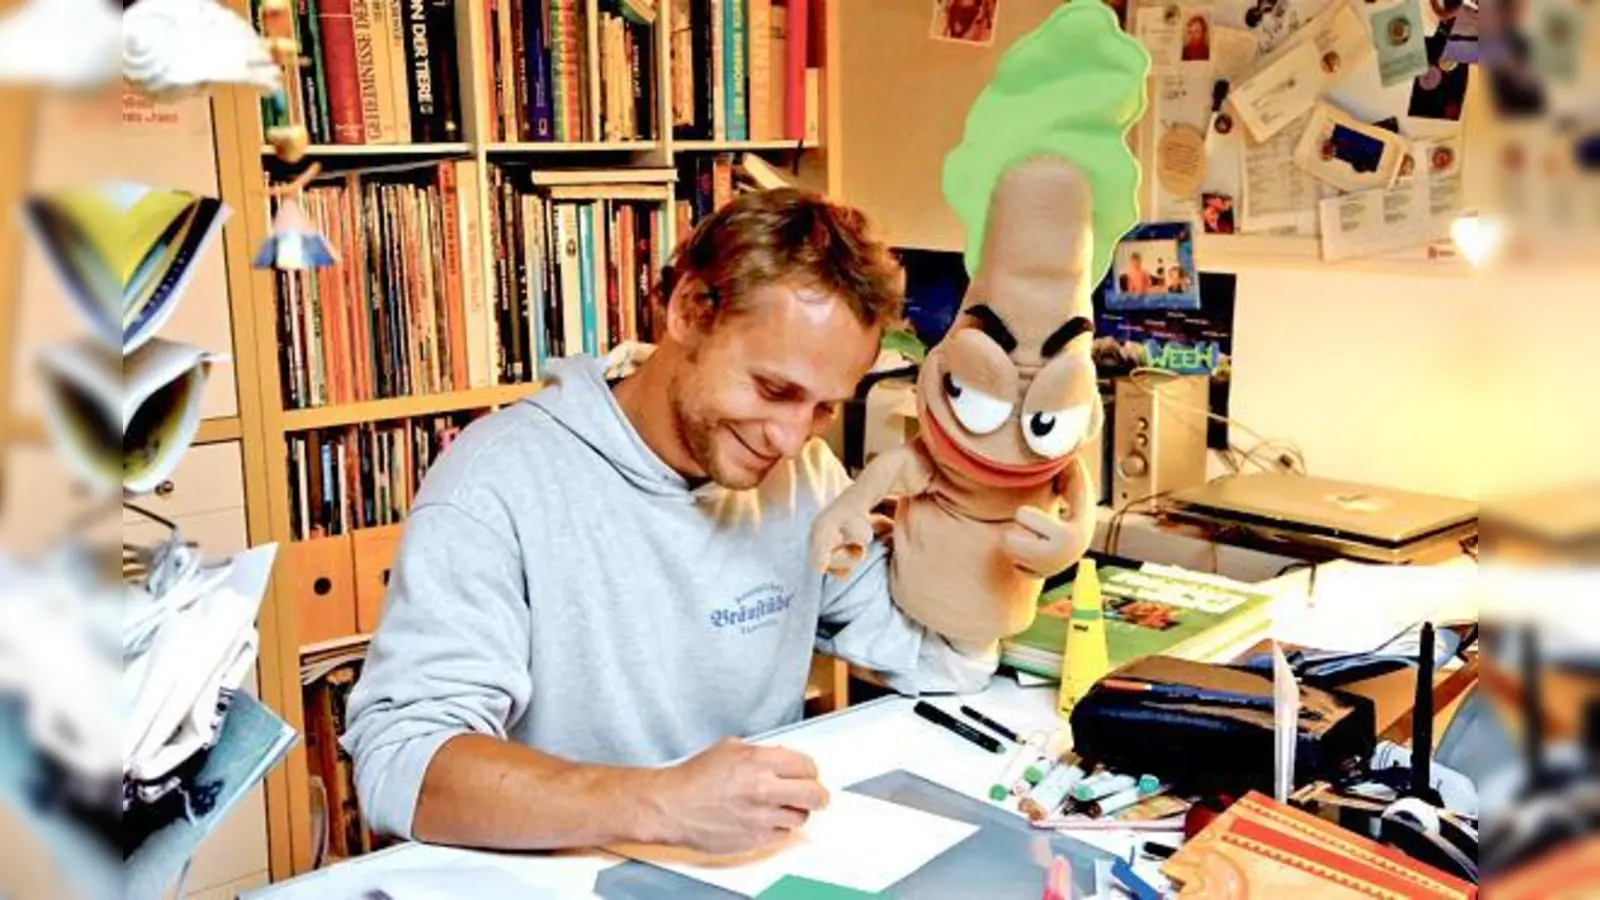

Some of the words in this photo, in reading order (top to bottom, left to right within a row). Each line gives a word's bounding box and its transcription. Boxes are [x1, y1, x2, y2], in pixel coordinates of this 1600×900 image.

[411, 23, 429, 58] DER
[356, 33, 382, 139] GEHEIMNISSE
[415, 60, 434, 105] TIERE
